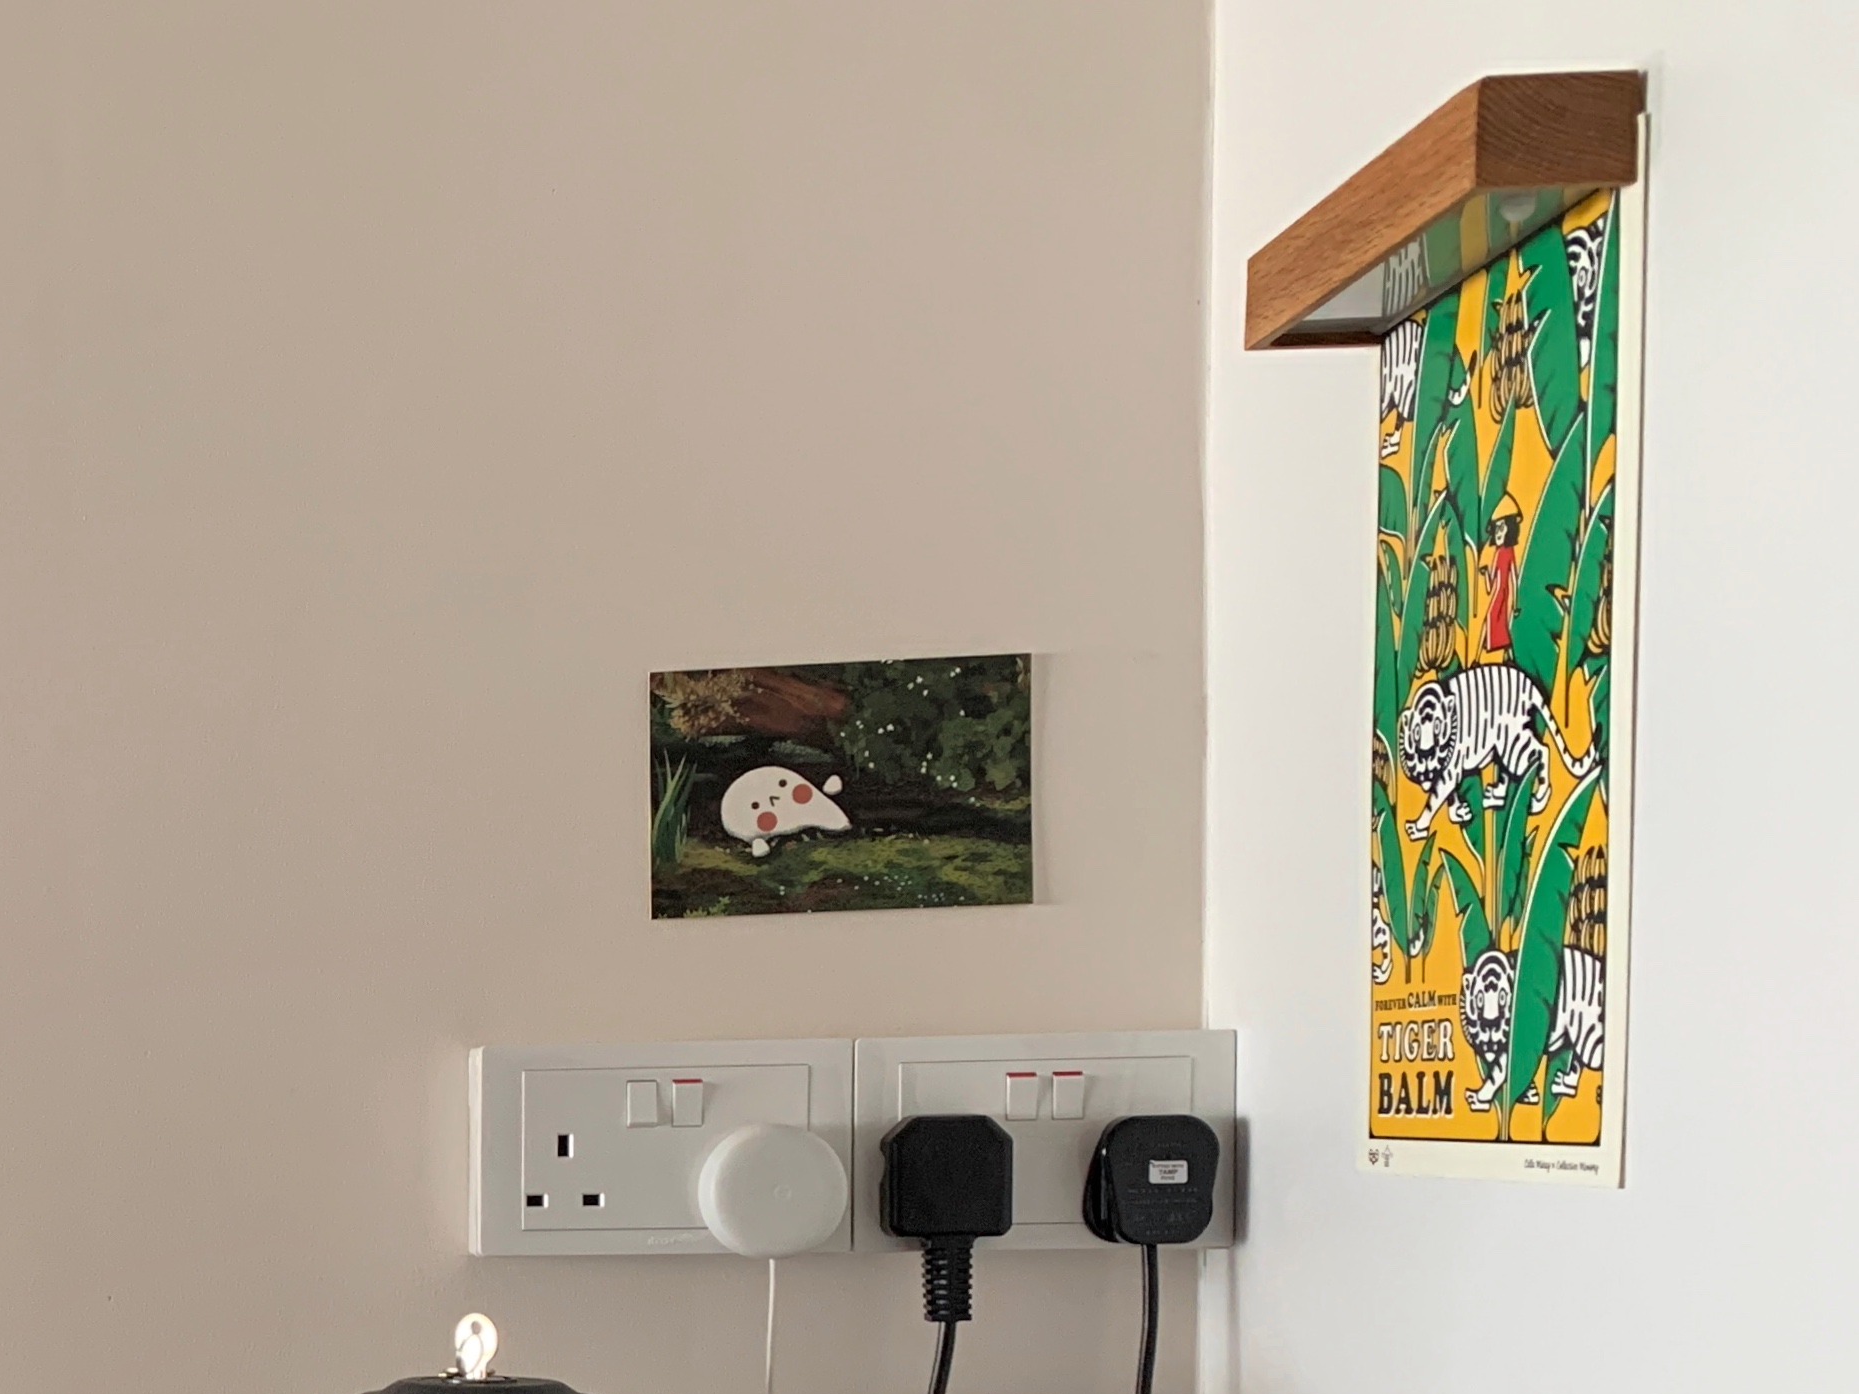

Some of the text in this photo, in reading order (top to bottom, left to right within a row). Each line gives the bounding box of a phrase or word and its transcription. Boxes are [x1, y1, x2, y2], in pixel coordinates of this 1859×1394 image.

[1375, 990, 1457, 1011] FOREVER CALM WITH
[1378, 1018, 1455, 1063] TIGER
[1378, 1070, 1455, 1119] BALM
